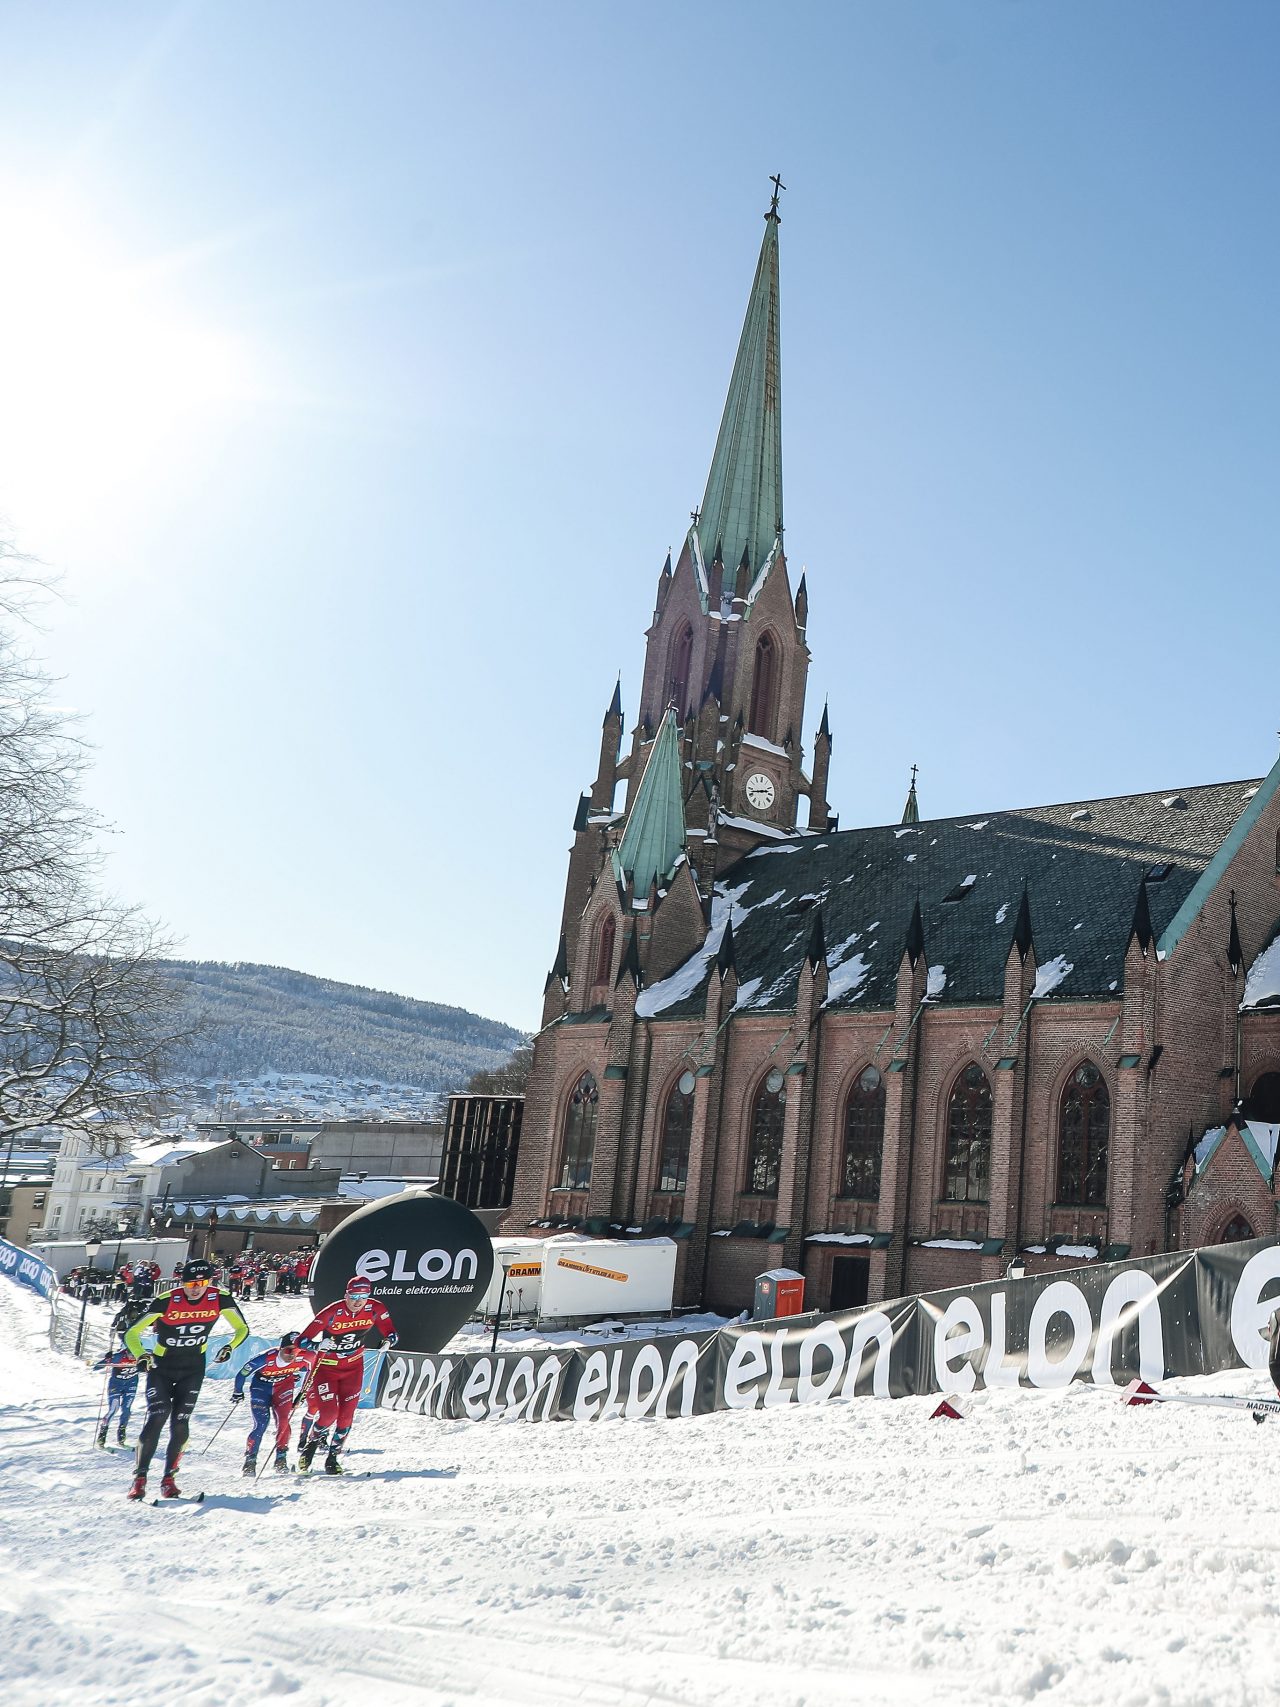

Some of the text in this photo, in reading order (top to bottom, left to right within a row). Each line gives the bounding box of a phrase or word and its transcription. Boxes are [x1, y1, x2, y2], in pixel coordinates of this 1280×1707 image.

[510, 1267, 542, 1276] DRAMM
[373, 1284, 475, 1295] lokale elektronikkbutikk
[180, 1310, 217, 1319] EXTRA
[341, 1319, 373, 1329] EXTRA
[175, 1325, 205, 1335] 19
[341, 1333, 356, 1343] 3
